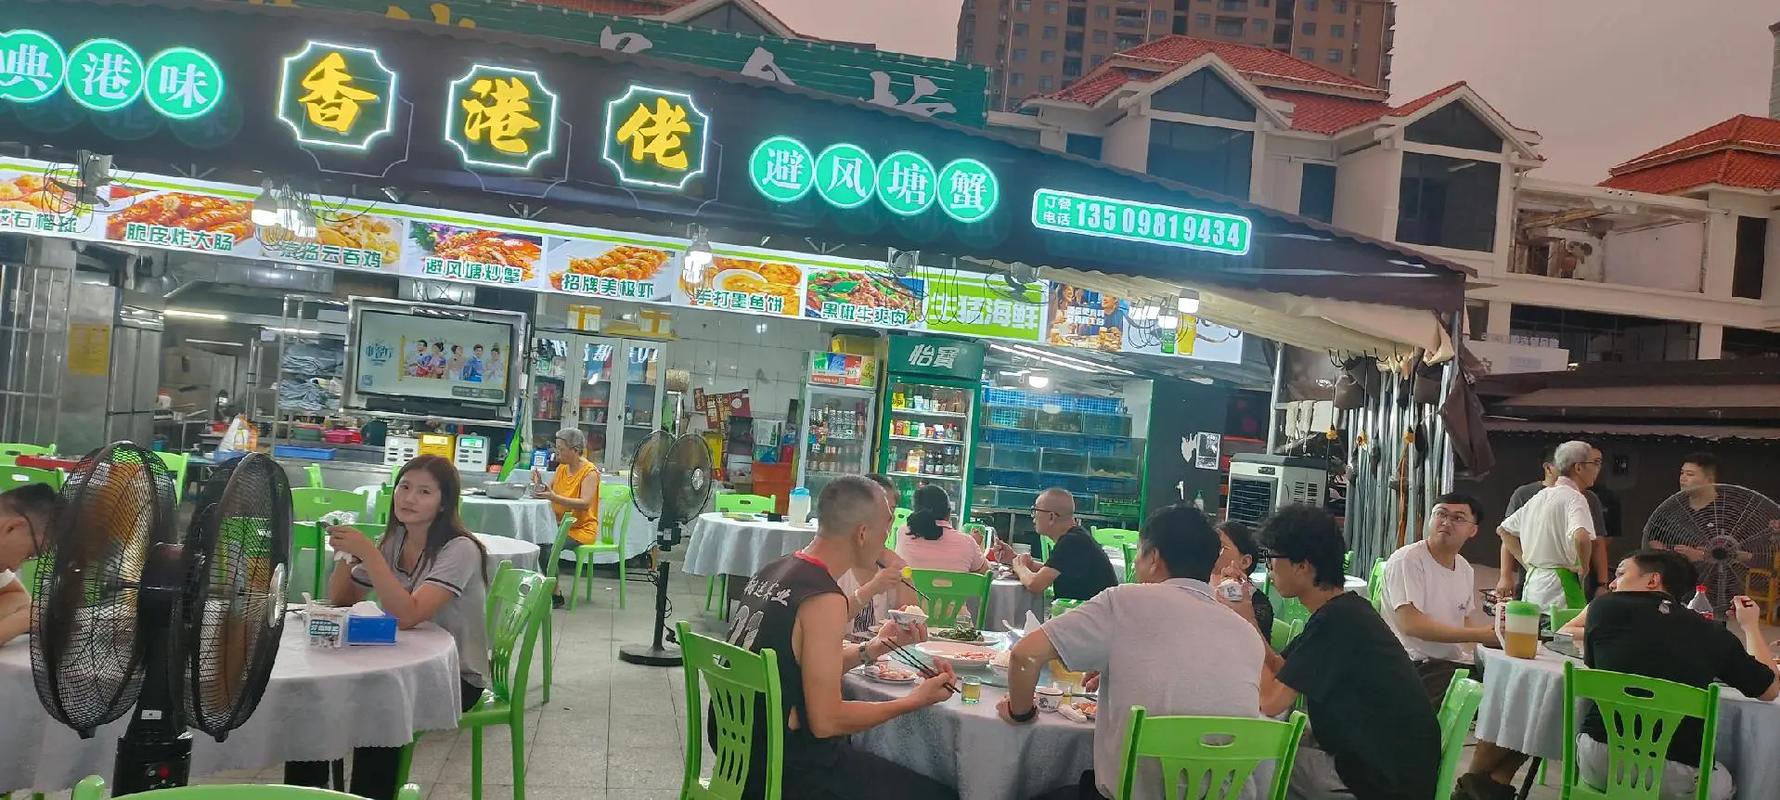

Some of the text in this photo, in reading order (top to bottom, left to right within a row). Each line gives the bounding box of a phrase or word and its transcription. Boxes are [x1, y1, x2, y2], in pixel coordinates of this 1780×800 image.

[0, 42, 209, 109] 典港味
[298, 51, 692, 171] 香港佬
[761, 147, 989, 214] 避风塘蟹
[1043, 195, 1072, 212] 订餐
[1042, 211, 1071, 227] 电话
[1076, 201, 1241, 248] 13509819434
[127, 223, 233, 251] 脆皮炸大肠
[425, 257, 522, 284] 避风塘炒蟹
[563, 274, 654, 299] 招牌美极虾
[697, 289, 783, 313] 手打墨鱼饼
[929, 292, 1041, 329] 生猛海鲜
